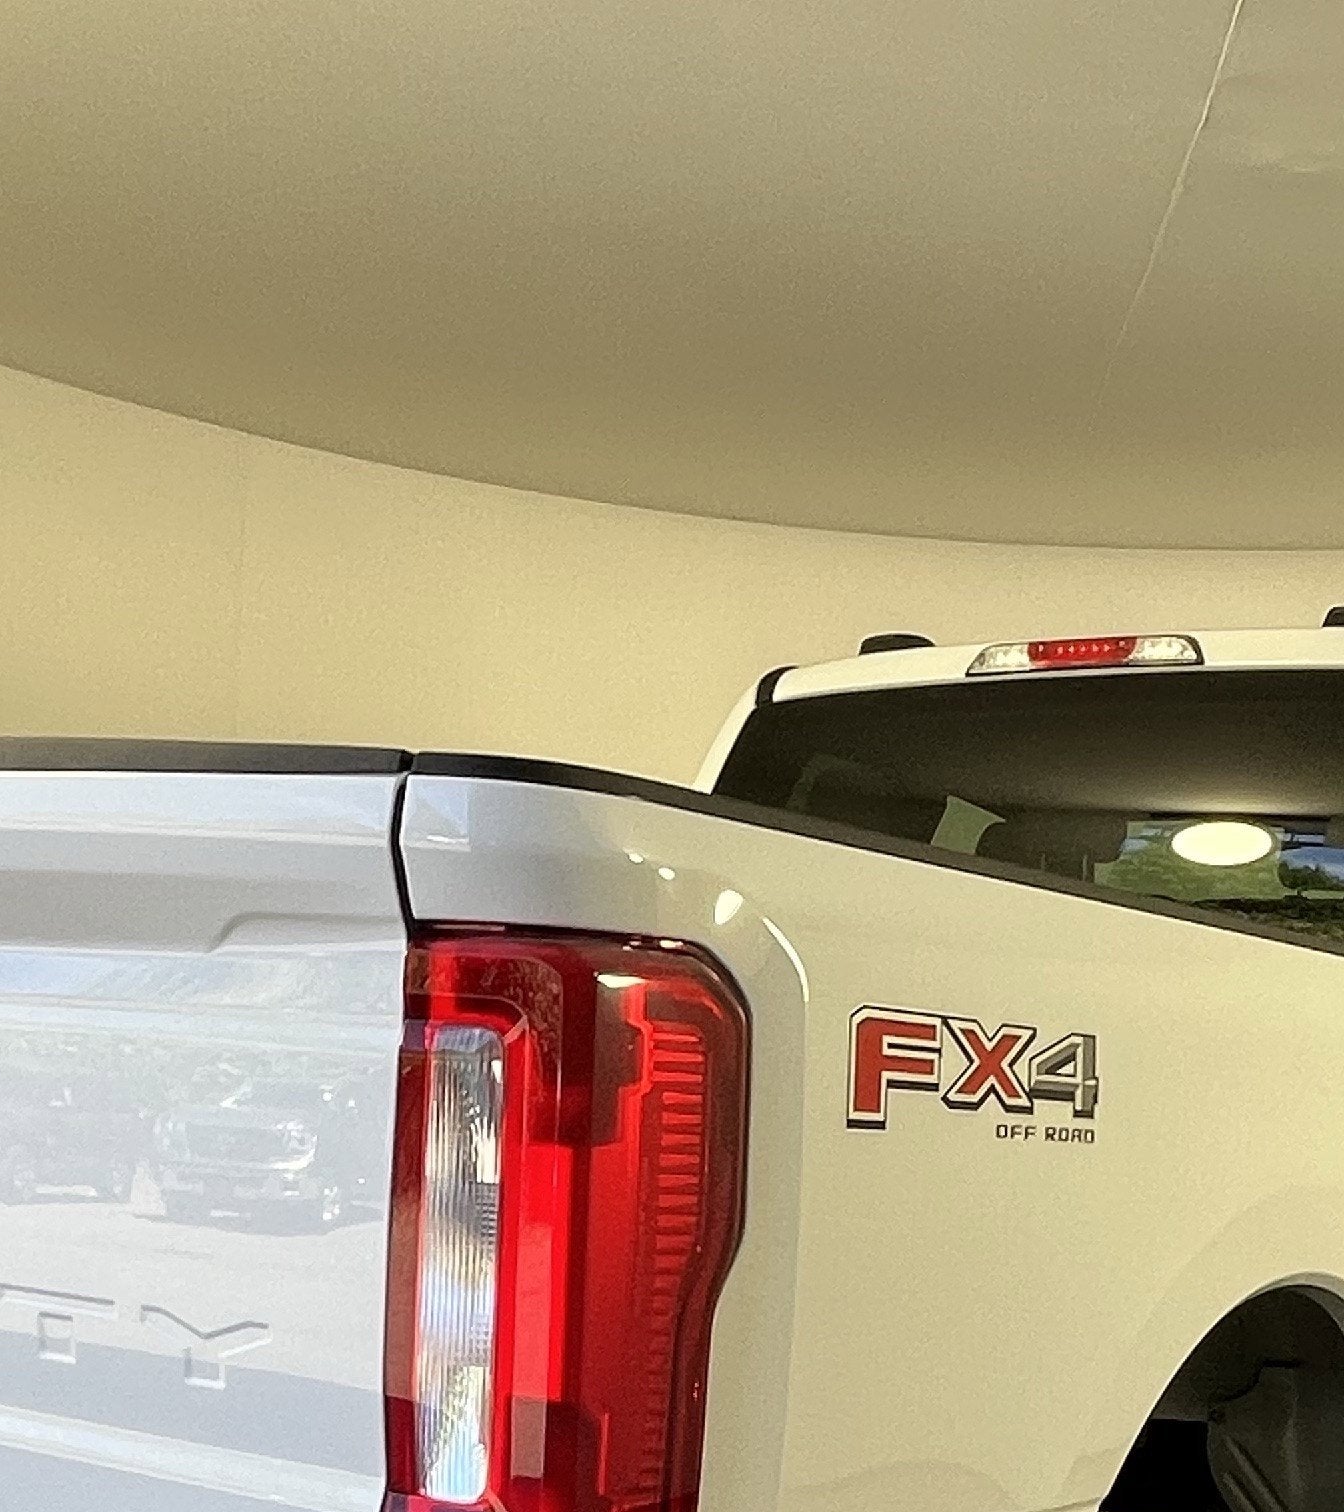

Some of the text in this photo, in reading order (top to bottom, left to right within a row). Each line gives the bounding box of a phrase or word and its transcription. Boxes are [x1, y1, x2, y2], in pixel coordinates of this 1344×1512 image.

[847, 1005, 1098, 1130] FX4
[995, 1124, 1095, 1144] OFF ROAD
